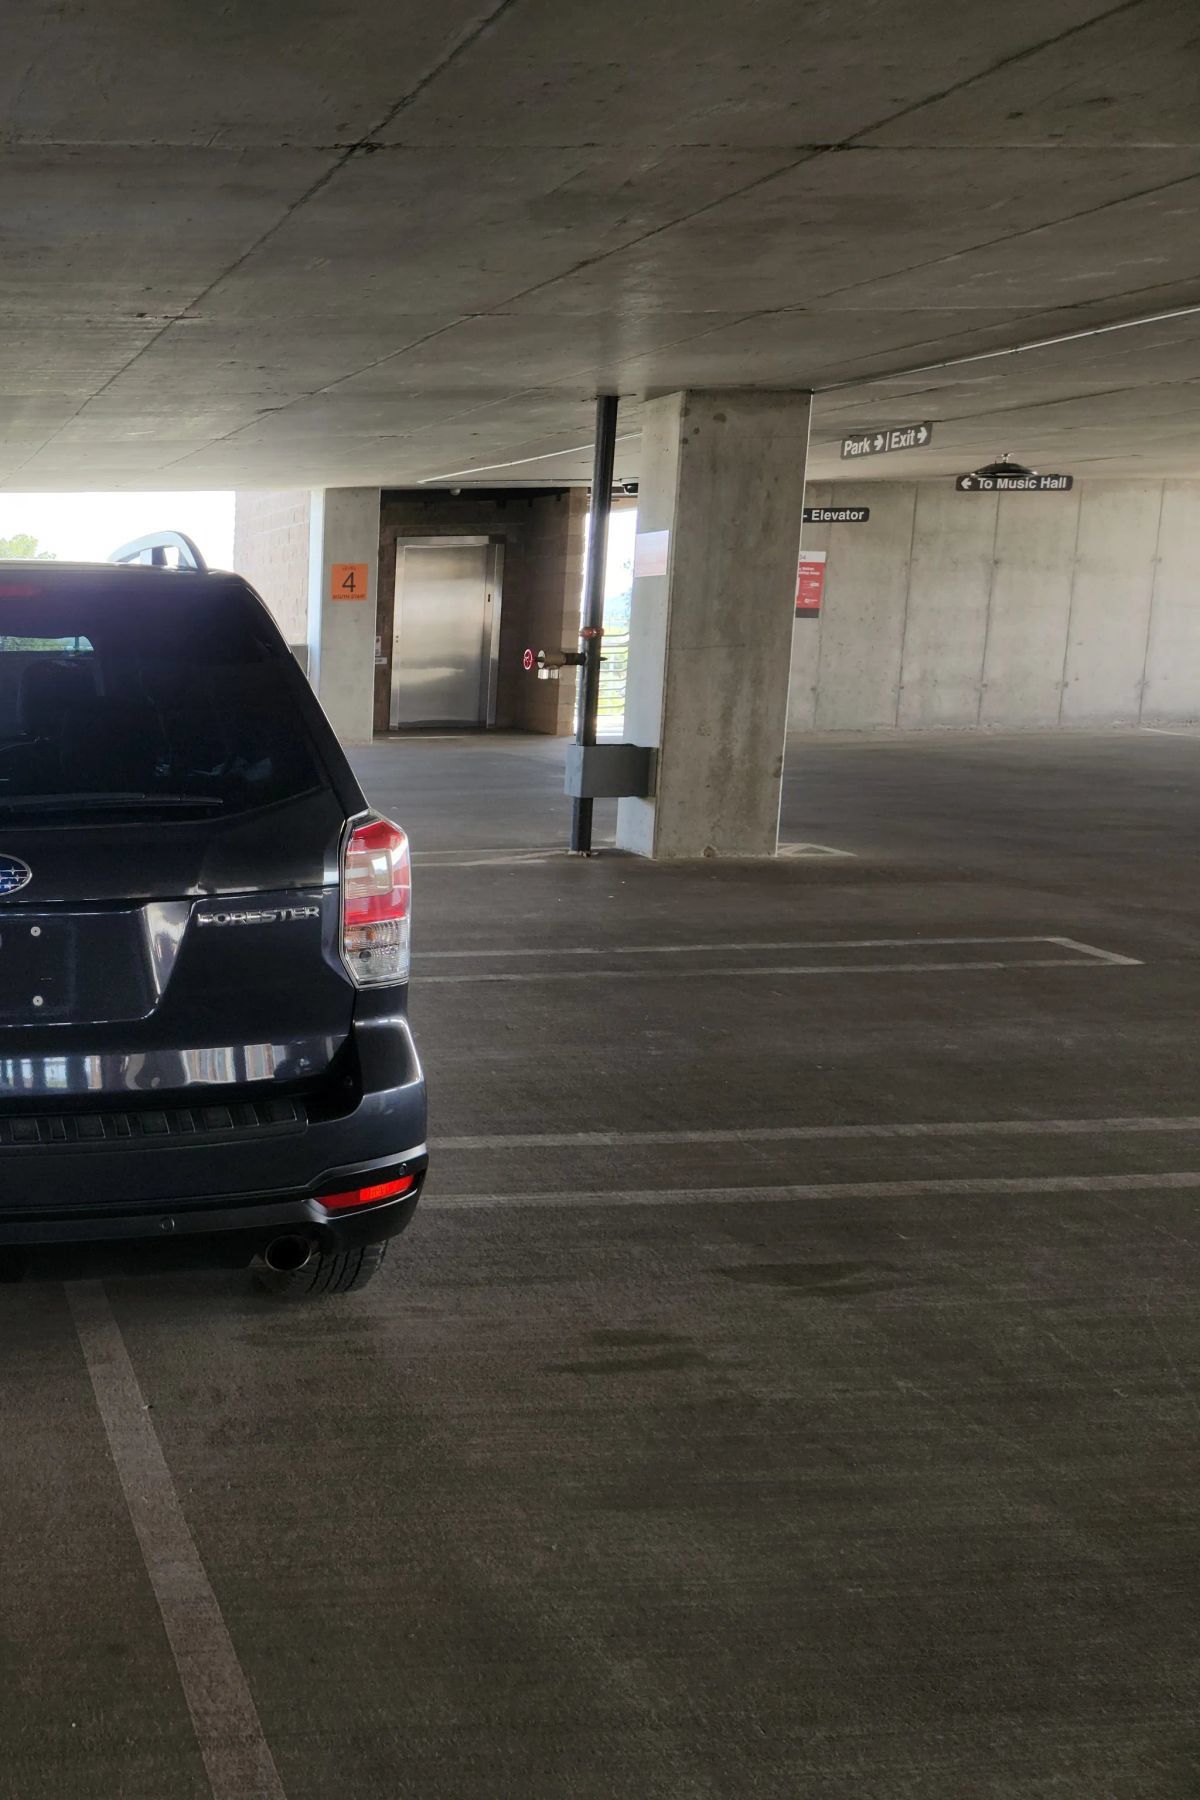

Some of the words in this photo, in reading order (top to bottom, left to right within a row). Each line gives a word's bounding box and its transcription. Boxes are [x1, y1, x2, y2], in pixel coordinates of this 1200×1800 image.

[844, 437, 870, 456] Park
[891, 429, 915, 448] Exit
[978, 477, 992, 489] To
[997, 478, 1036, 489] Music
[1041, 477, 1066, 489] Hall
[811, 509, 864, 521] Elevator
[342, 571, 356, 593] 4
[197, 905, 320, 927] FORESTER
